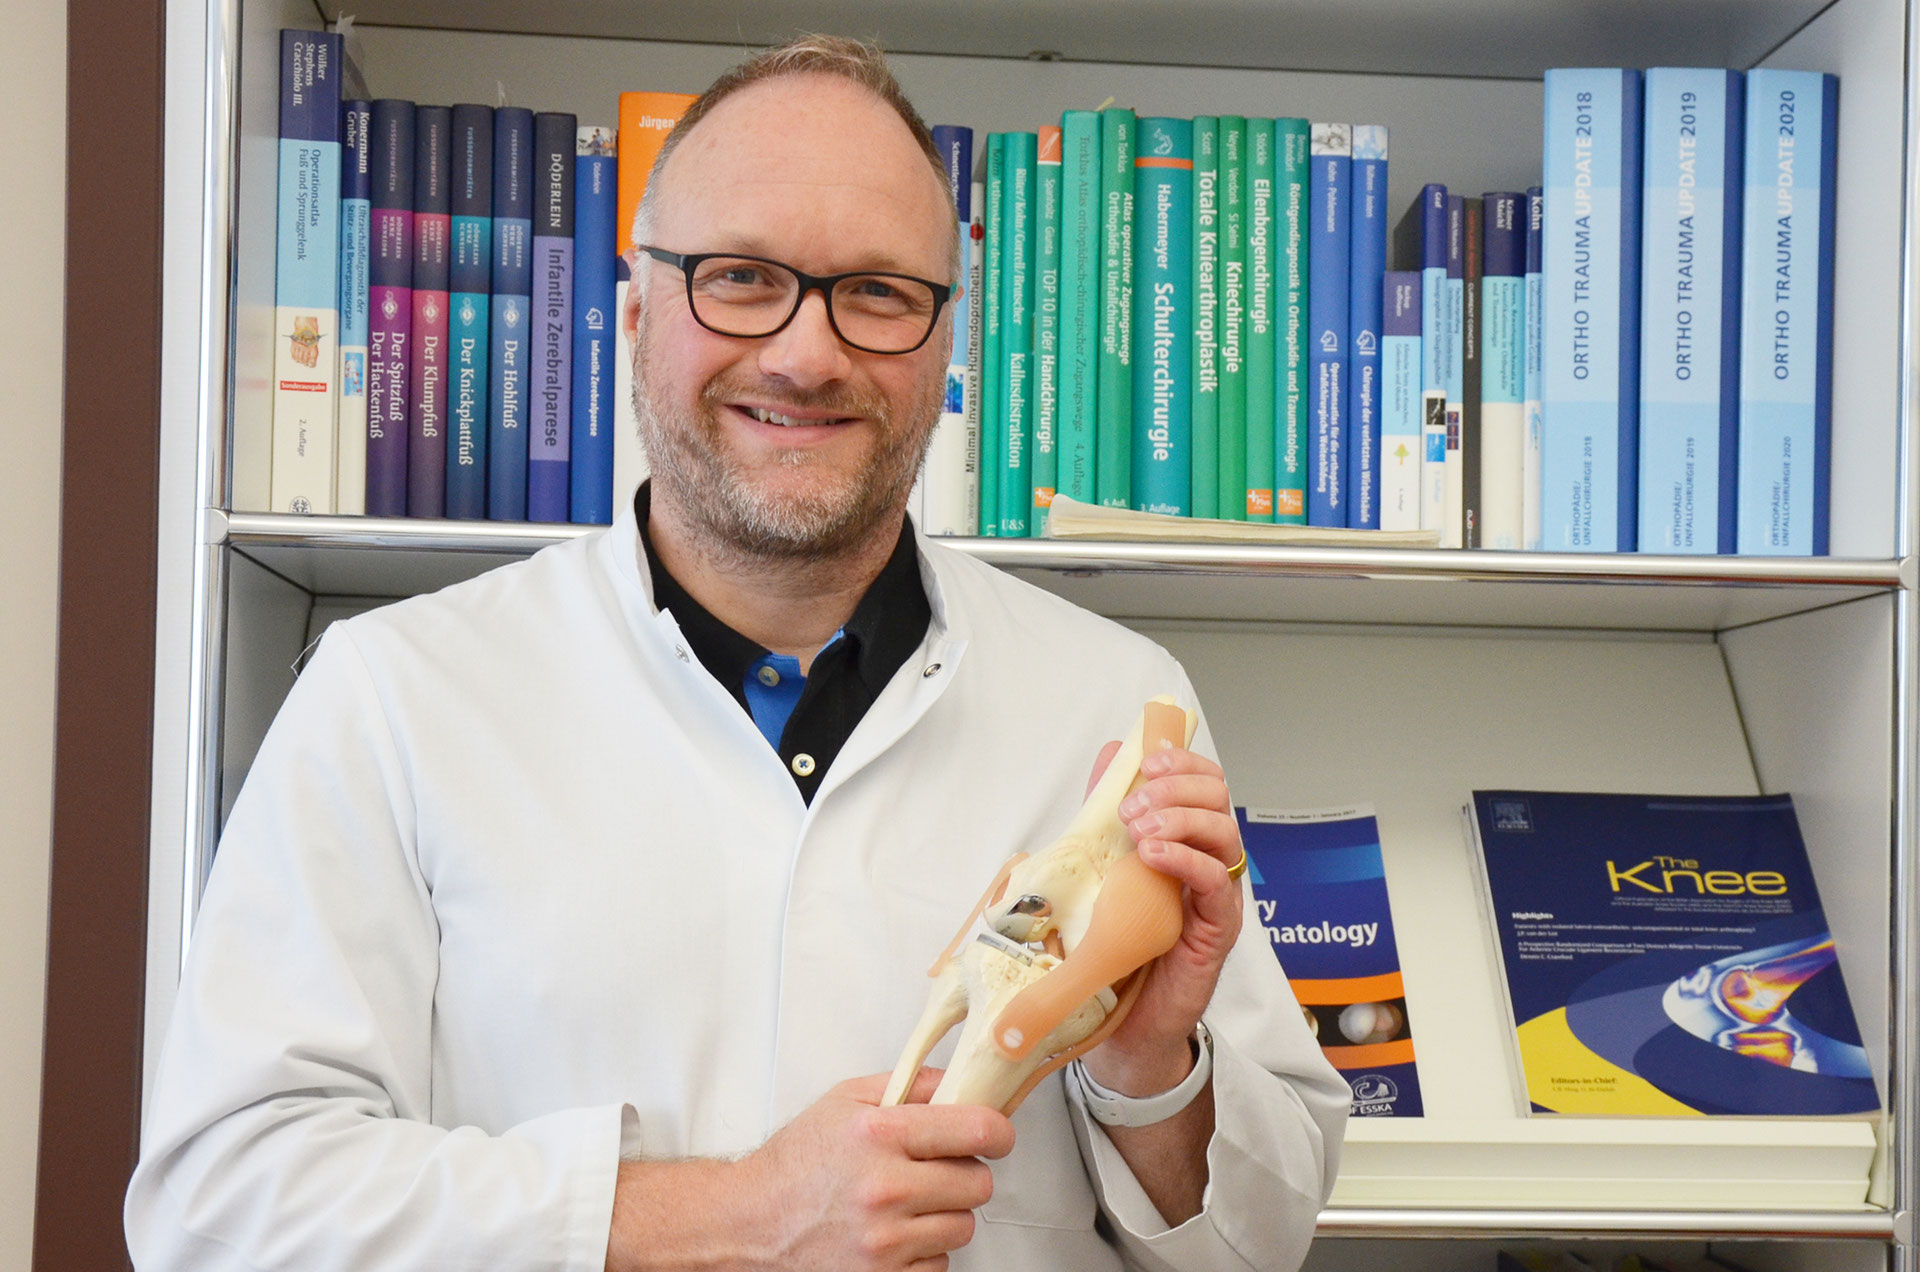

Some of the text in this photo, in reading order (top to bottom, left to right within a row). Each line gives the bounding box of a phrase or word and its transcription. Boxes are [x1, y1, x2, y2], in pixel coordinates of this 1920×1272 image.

[292, 41, 304, 107] Cracchiolo III.
[304, 42, 316, 87] Stephens
[317, 43, 328, 80] Wülker
[346, 110, 358, 149] Gruber
[358, 110, 370, 174] Konermann
[638, 115, 676, 131] Jürgen
[1079, 135, 1092, 177] Torklus
[1117, 123, 1128, 174] von Torklus
[1227, 130, 1239, 161] Neyret
[295, 147, 309, 261] Fuß und Sprunggelenk
[307, 148, 322, 227] Operationsatlas
[549, 152, 565, 228] DÖDERLEIN
[592, 161, 603, 195] Döderlein
[1078, 180, 1090, 209] Atlas
[1228, 167, 1239, 206] Verdonk
[1434, 191, 1443, 208] Graf
[989, 178, 1002, 247] Arthroskopie
[1043, 225, 1055, 255] Giunta
[1250, 131, 1271, 335] Stöckle Ellenbogenchirurgie
[1530, 195, 1543, 231] Kohn
[344, 203, 356, 331] Stütz- und Bewegungsorgane
[356, 204, 368, 315] Ultraschalldiagnostik der
[989, 247, 1000, 267] des
[1042, 268, 1056, 293] TOP
[1103, 190, 1121, 355] Orthopädie & Unfallchirurgie
[1118, 191, 1134, 366] Atlas operativer Zugangswege
[1194, 131, 1218, 394] Scott Totale Kniearthroplastik
[968, 264, 981, 372] Hüftendoprothetik
[987, 268, 1000, 336] Kniegelenks
[1042, 297, 1056, 312] 10
[1042, 315, 1056, 327] in
[1148, 183, 1175, 462] Habermeyer Schulterchirurgie
[1222, 260, 1243, 374] Kniechirurgie
[1283, 181, 1301, 473] Röntgendiagnostik in Orthopädie und Traumatologie
[541, 248, 565, 447] Infantile Zerebralparese
[1041, 330, 1056, 351] der
[1573, 310, 1590, 381] ORTHO
[1675, 310, 1692, 382] ORTHO
[1774, 310, 1790, 381] ORTHO
[369, 331, 386, 439] Der Hackenfuß
[386, 331, 406, 422] Der Spitzfuß
[418, 335, 439, 438] Der Klumpfuß
[455, 337, 476, 466] Der Knickplattfuß
[502, 339, 519, 429] Der Hohlfuß
[588, 339, 601, 438] Infantile Zerebralparese
[966, 375, 978, 425] invasive
[1036, 353, 1056, 454] Handchirurgie
[1072, 358, 1087, 432] Zugangswege
[1328, 362, 1340, 425] Operationsatlas
[297, 428, 307, 458] Auflage
[1008, 352, 1027, 469] Kallusdistraktion
[1329, 426, 1340, 440] für
[1360, 365, 1373, 523] Chirurgie der verletzten Wirbelsäule
[965, 428, 977, 473] Minimal
[1072, 454, 1086, 497] Auflage
[1074, 442, 1085, 451] 4.
[1316, 434, 1328, 493] Weiterbildung
[1329, 441, 1339, 452] die
[1582, 435, 1593, 547] UNFALLCHIRURGIE 2018
[1684, 437, 1695, 548] UNFALLCHIRURGIE 2019
[1781, 435, 1792, 548] UNFALLCHIRURGIE 2020
[1605, 859, 1789, 896] Knee
[1653, 855, 1699, 870] The
[1359, 1102, 1393, 1115] ESSKA
